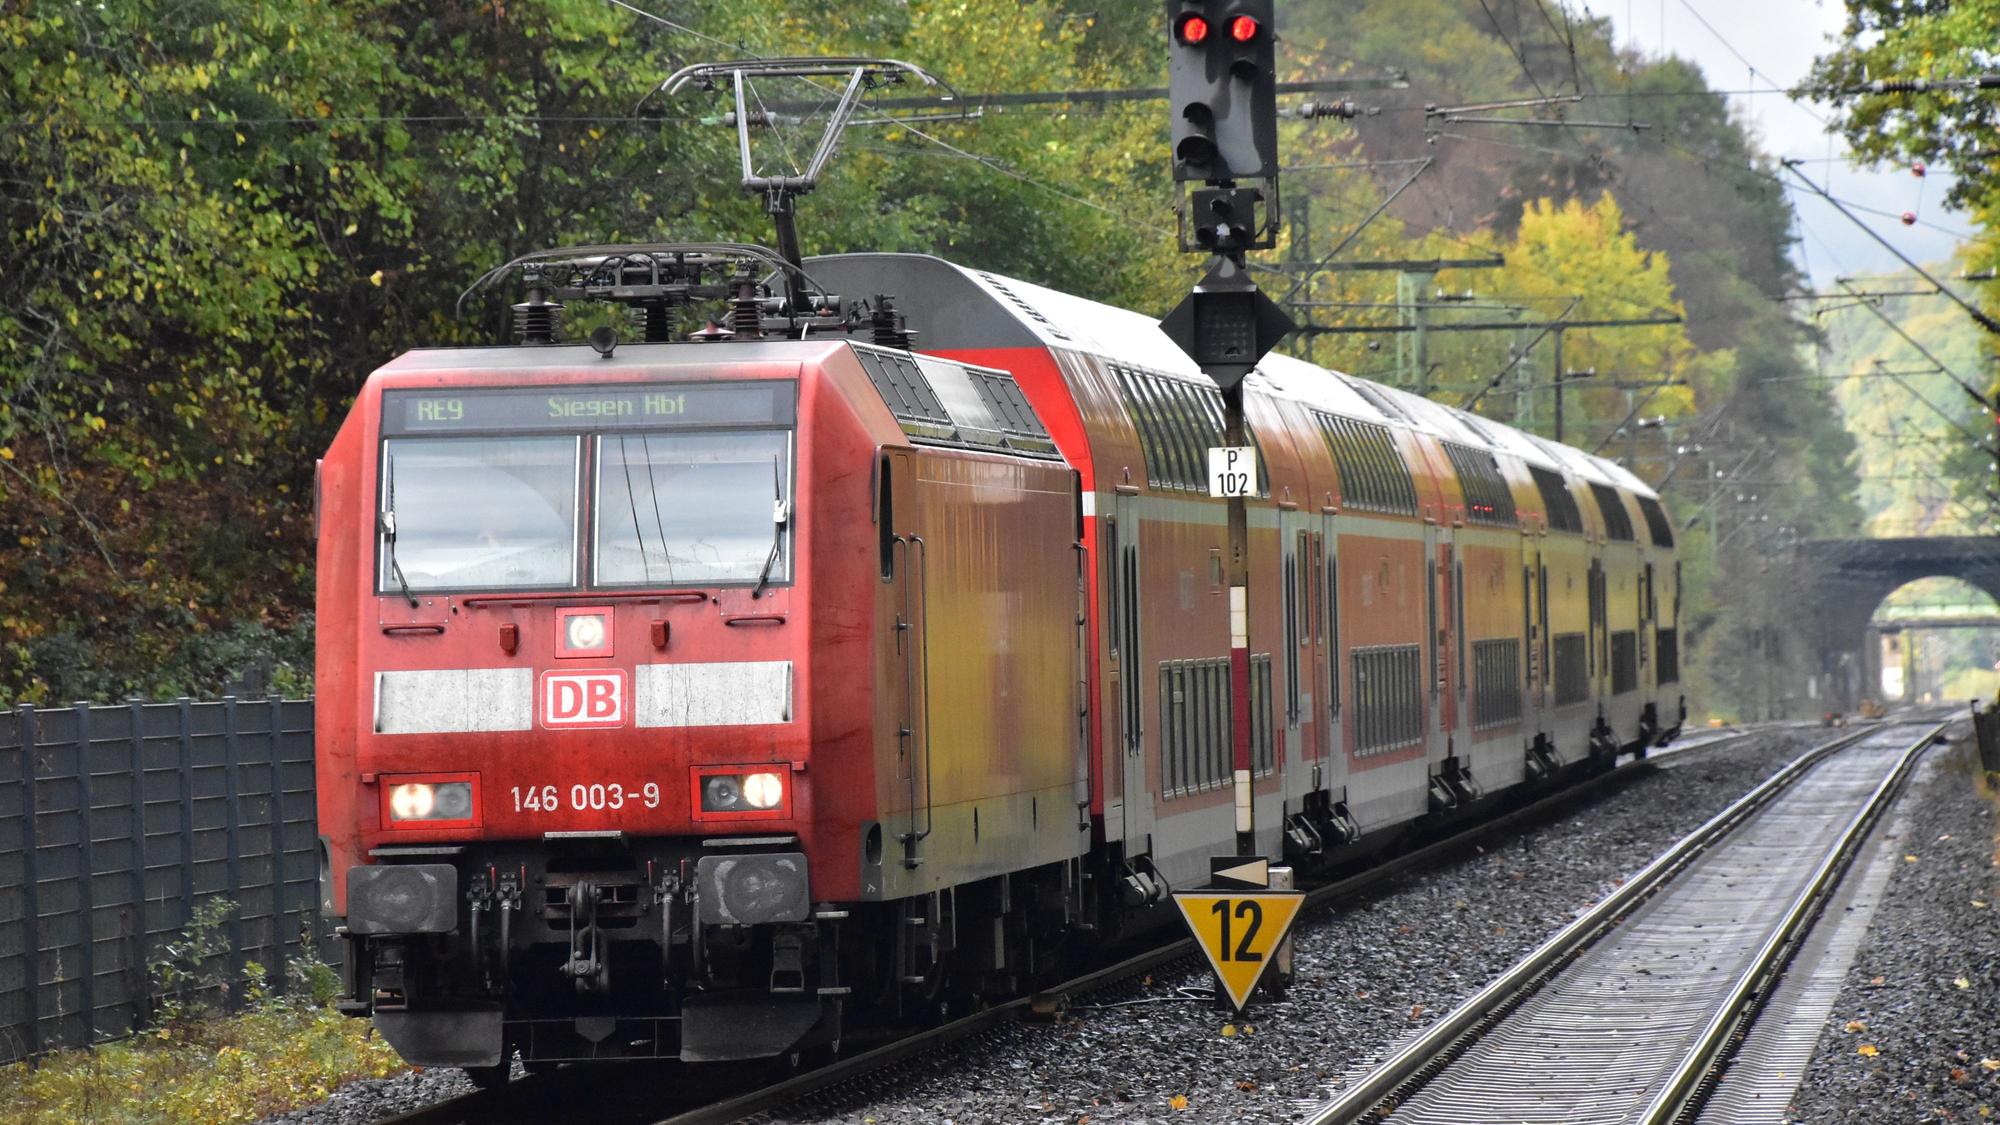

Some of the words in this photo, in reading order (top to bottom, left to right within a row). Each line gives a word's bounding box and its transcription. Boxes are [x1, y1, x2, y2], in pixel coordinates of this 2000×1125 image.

[417, 399, 464, 421] RE9
[547, 396, 634, 419] Siegen
[643, 393, 688, 416] Hbf
[1227, 450, 1238, 471] P
[1217, 473, 1249, 494] 102
[552, 679, 617, 719] DB
[510, 785, 558, 813] 146
[570, 783, 661, 811] 003-9
[1211, 899, 1263, 962] 12
